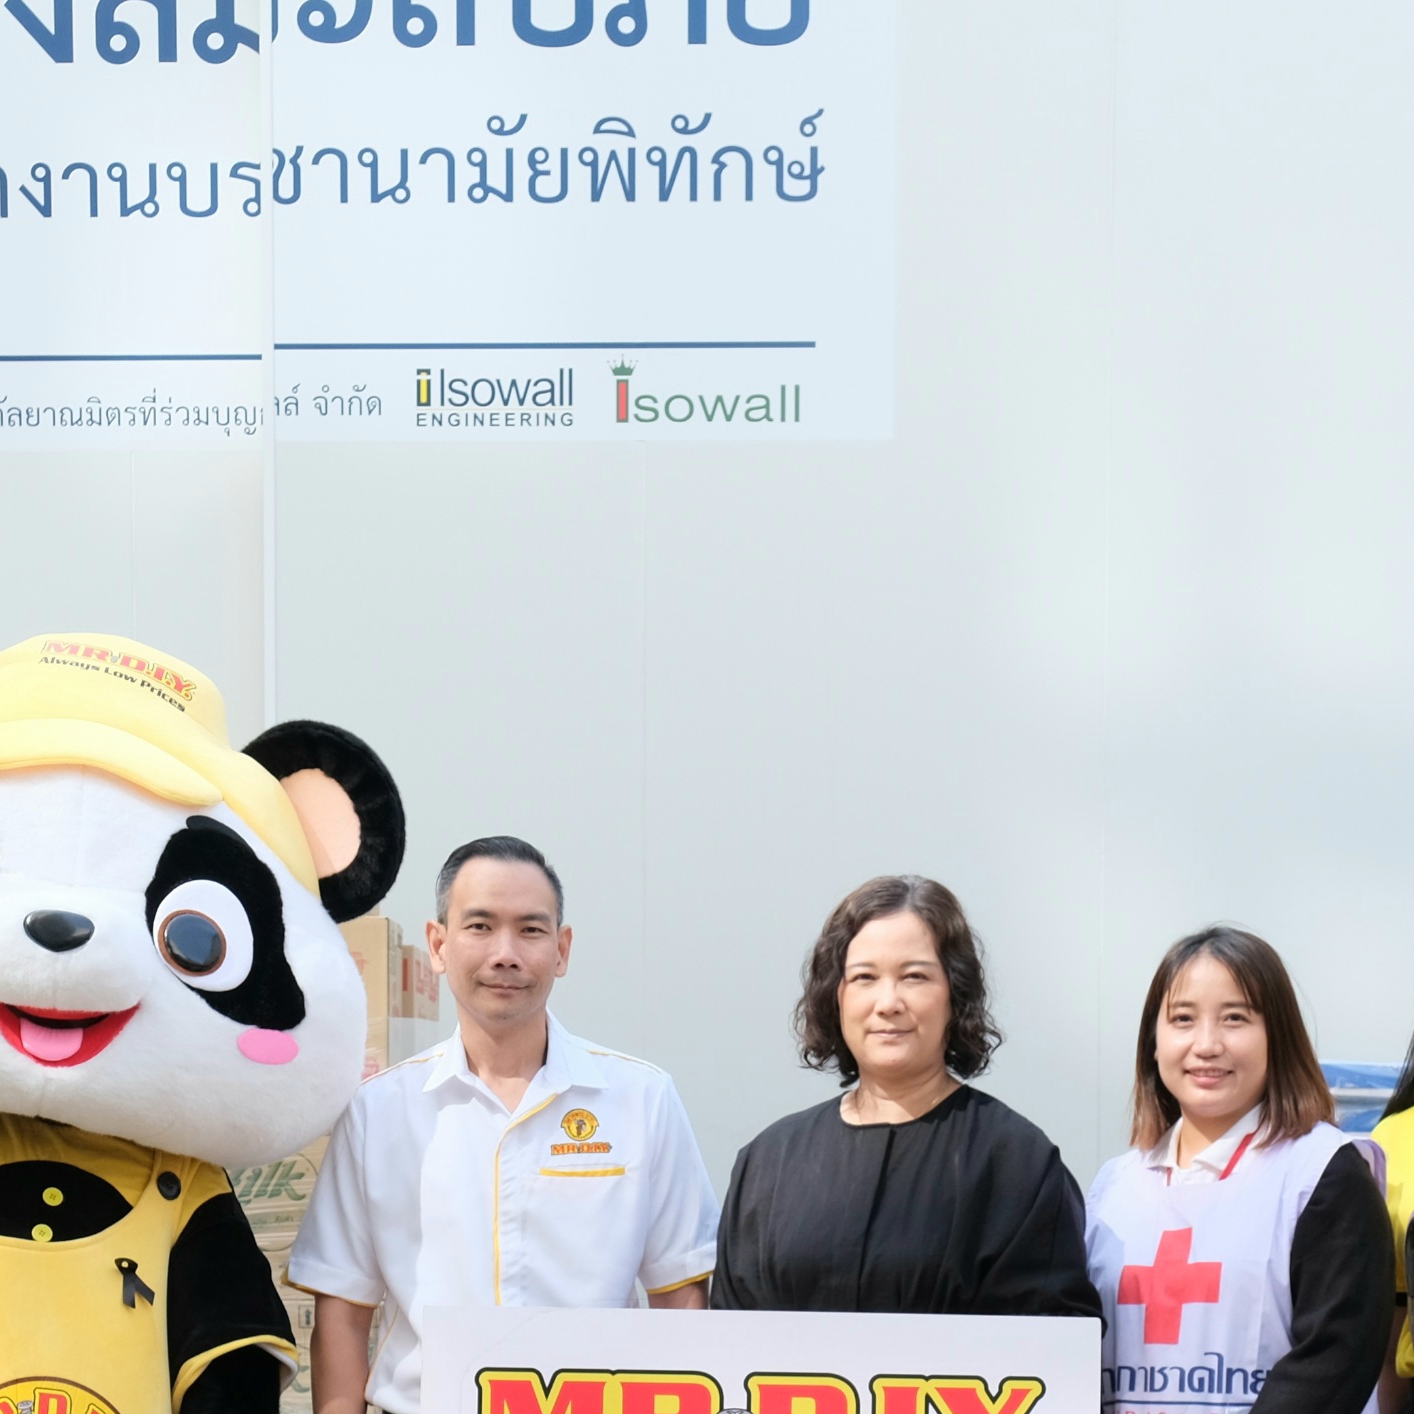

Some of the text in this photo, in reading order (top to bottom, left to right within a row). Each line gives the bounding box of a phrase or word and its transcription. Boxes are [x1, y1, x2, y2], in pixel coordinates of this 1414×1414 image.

[313, 384, 382, 416] จำกัด
[416, 412, 574, 428] ENGINEERING
[38, 655, 187, 713] Always Low Prices
